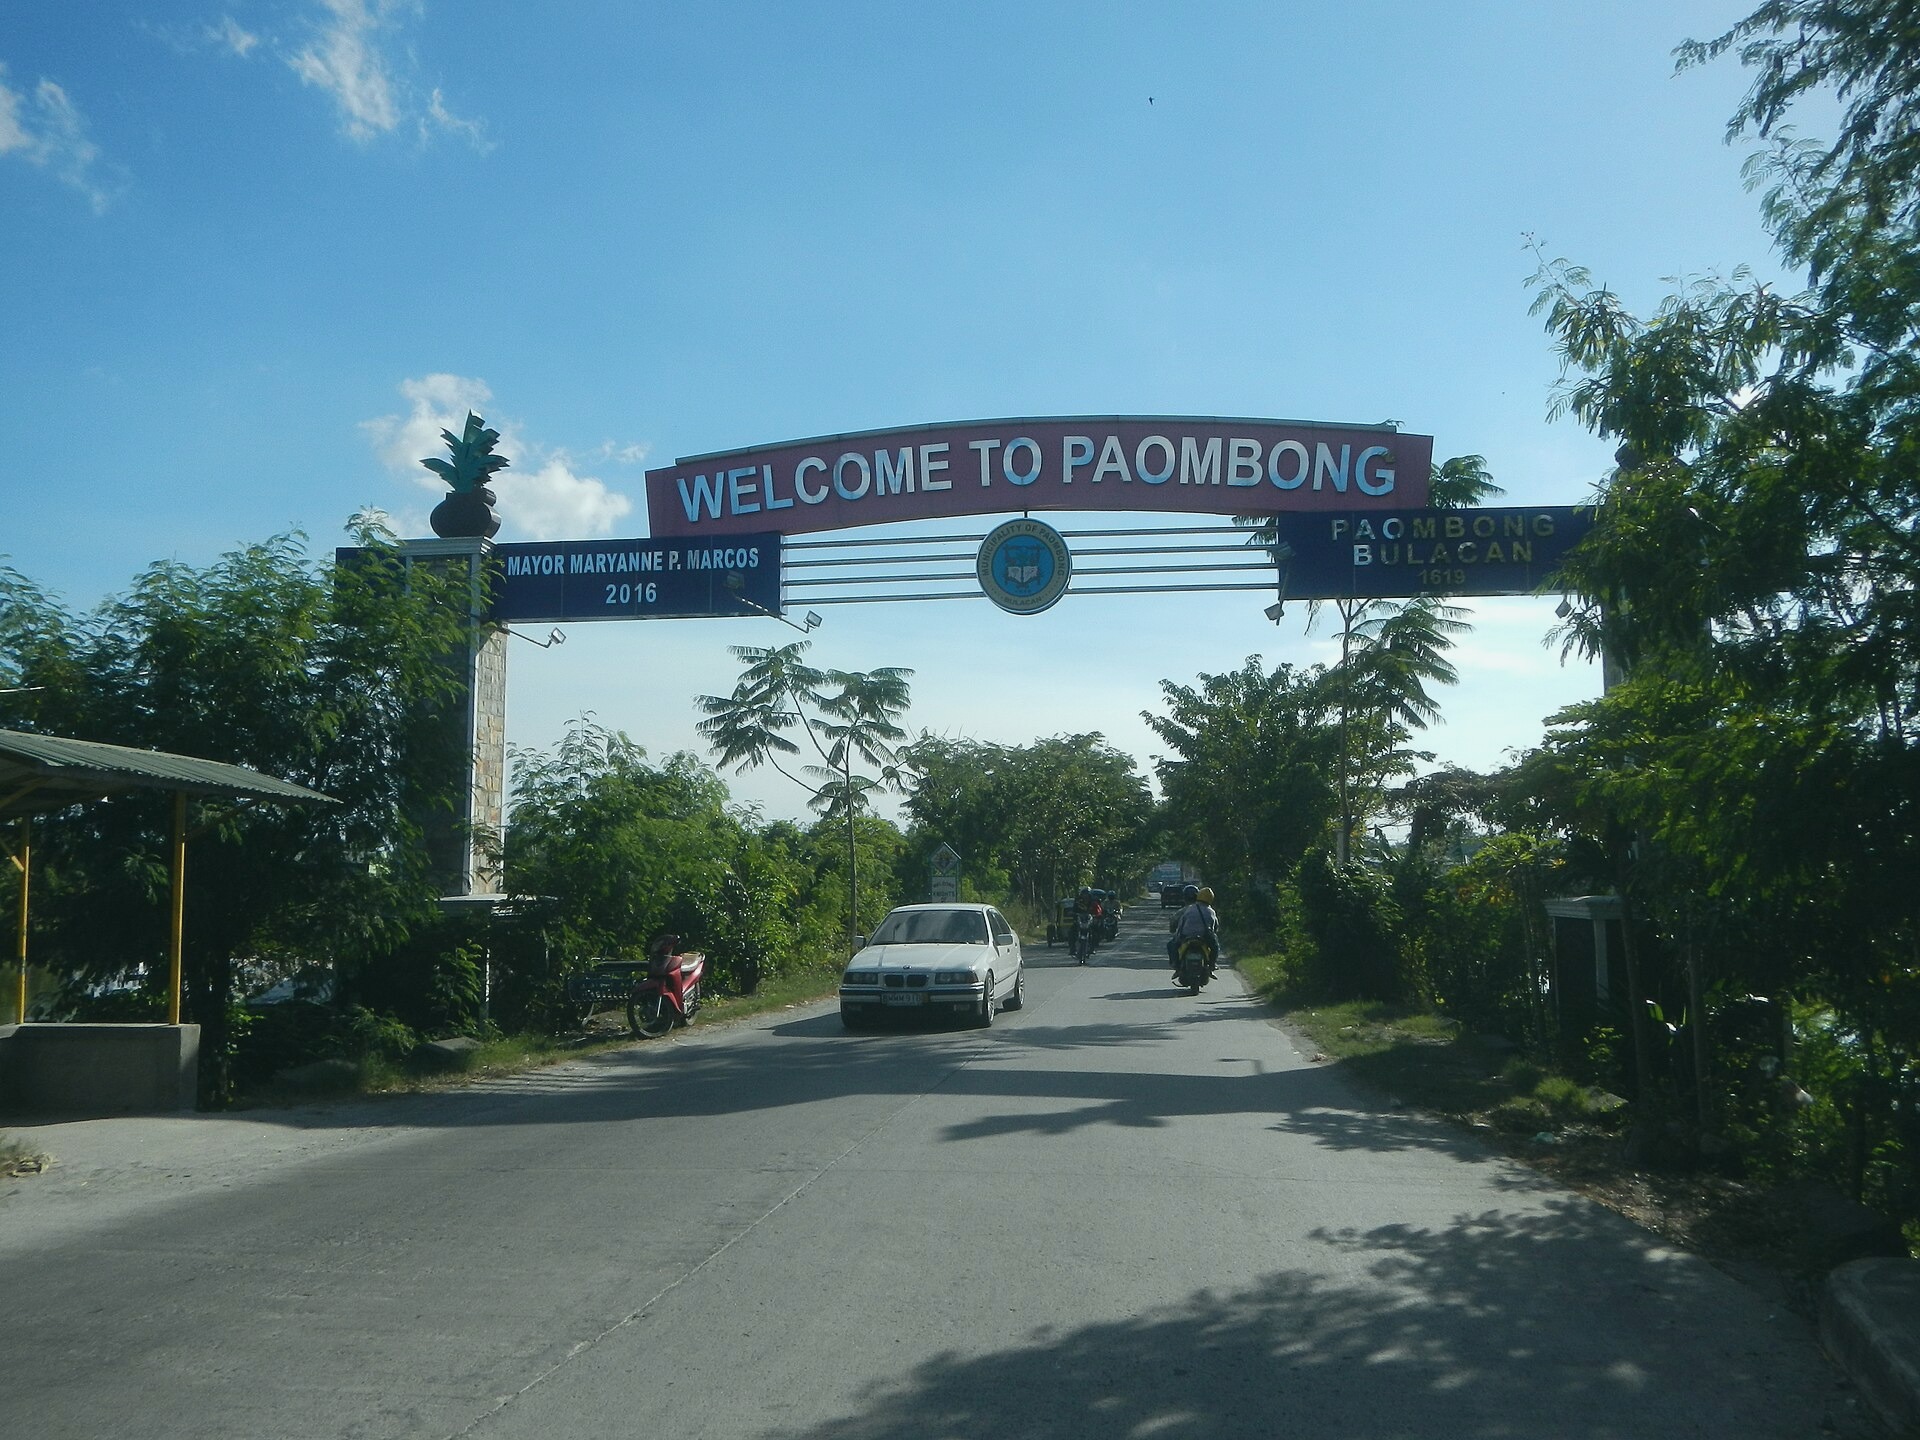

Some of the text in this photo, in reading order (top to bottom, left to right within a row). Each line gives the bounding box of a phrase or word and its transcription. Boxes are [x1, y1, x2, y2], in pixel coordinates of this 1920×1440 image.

[677, 435, 1396, 522] WELCOME TO PAOMBONG
[1331, 514, 1555, 541] PAOMBONG
[507, 547, 759, 576] MAYOR MARYANNE P. MARCOS
[981, 524, 1065, 576] MUNICIPALITY OF PAOMBONG
[1353, 541, 1533, 566] BULACAN
[1419, 569, 1466, 585] 1619
[605, 582, 657, 604] 2016
